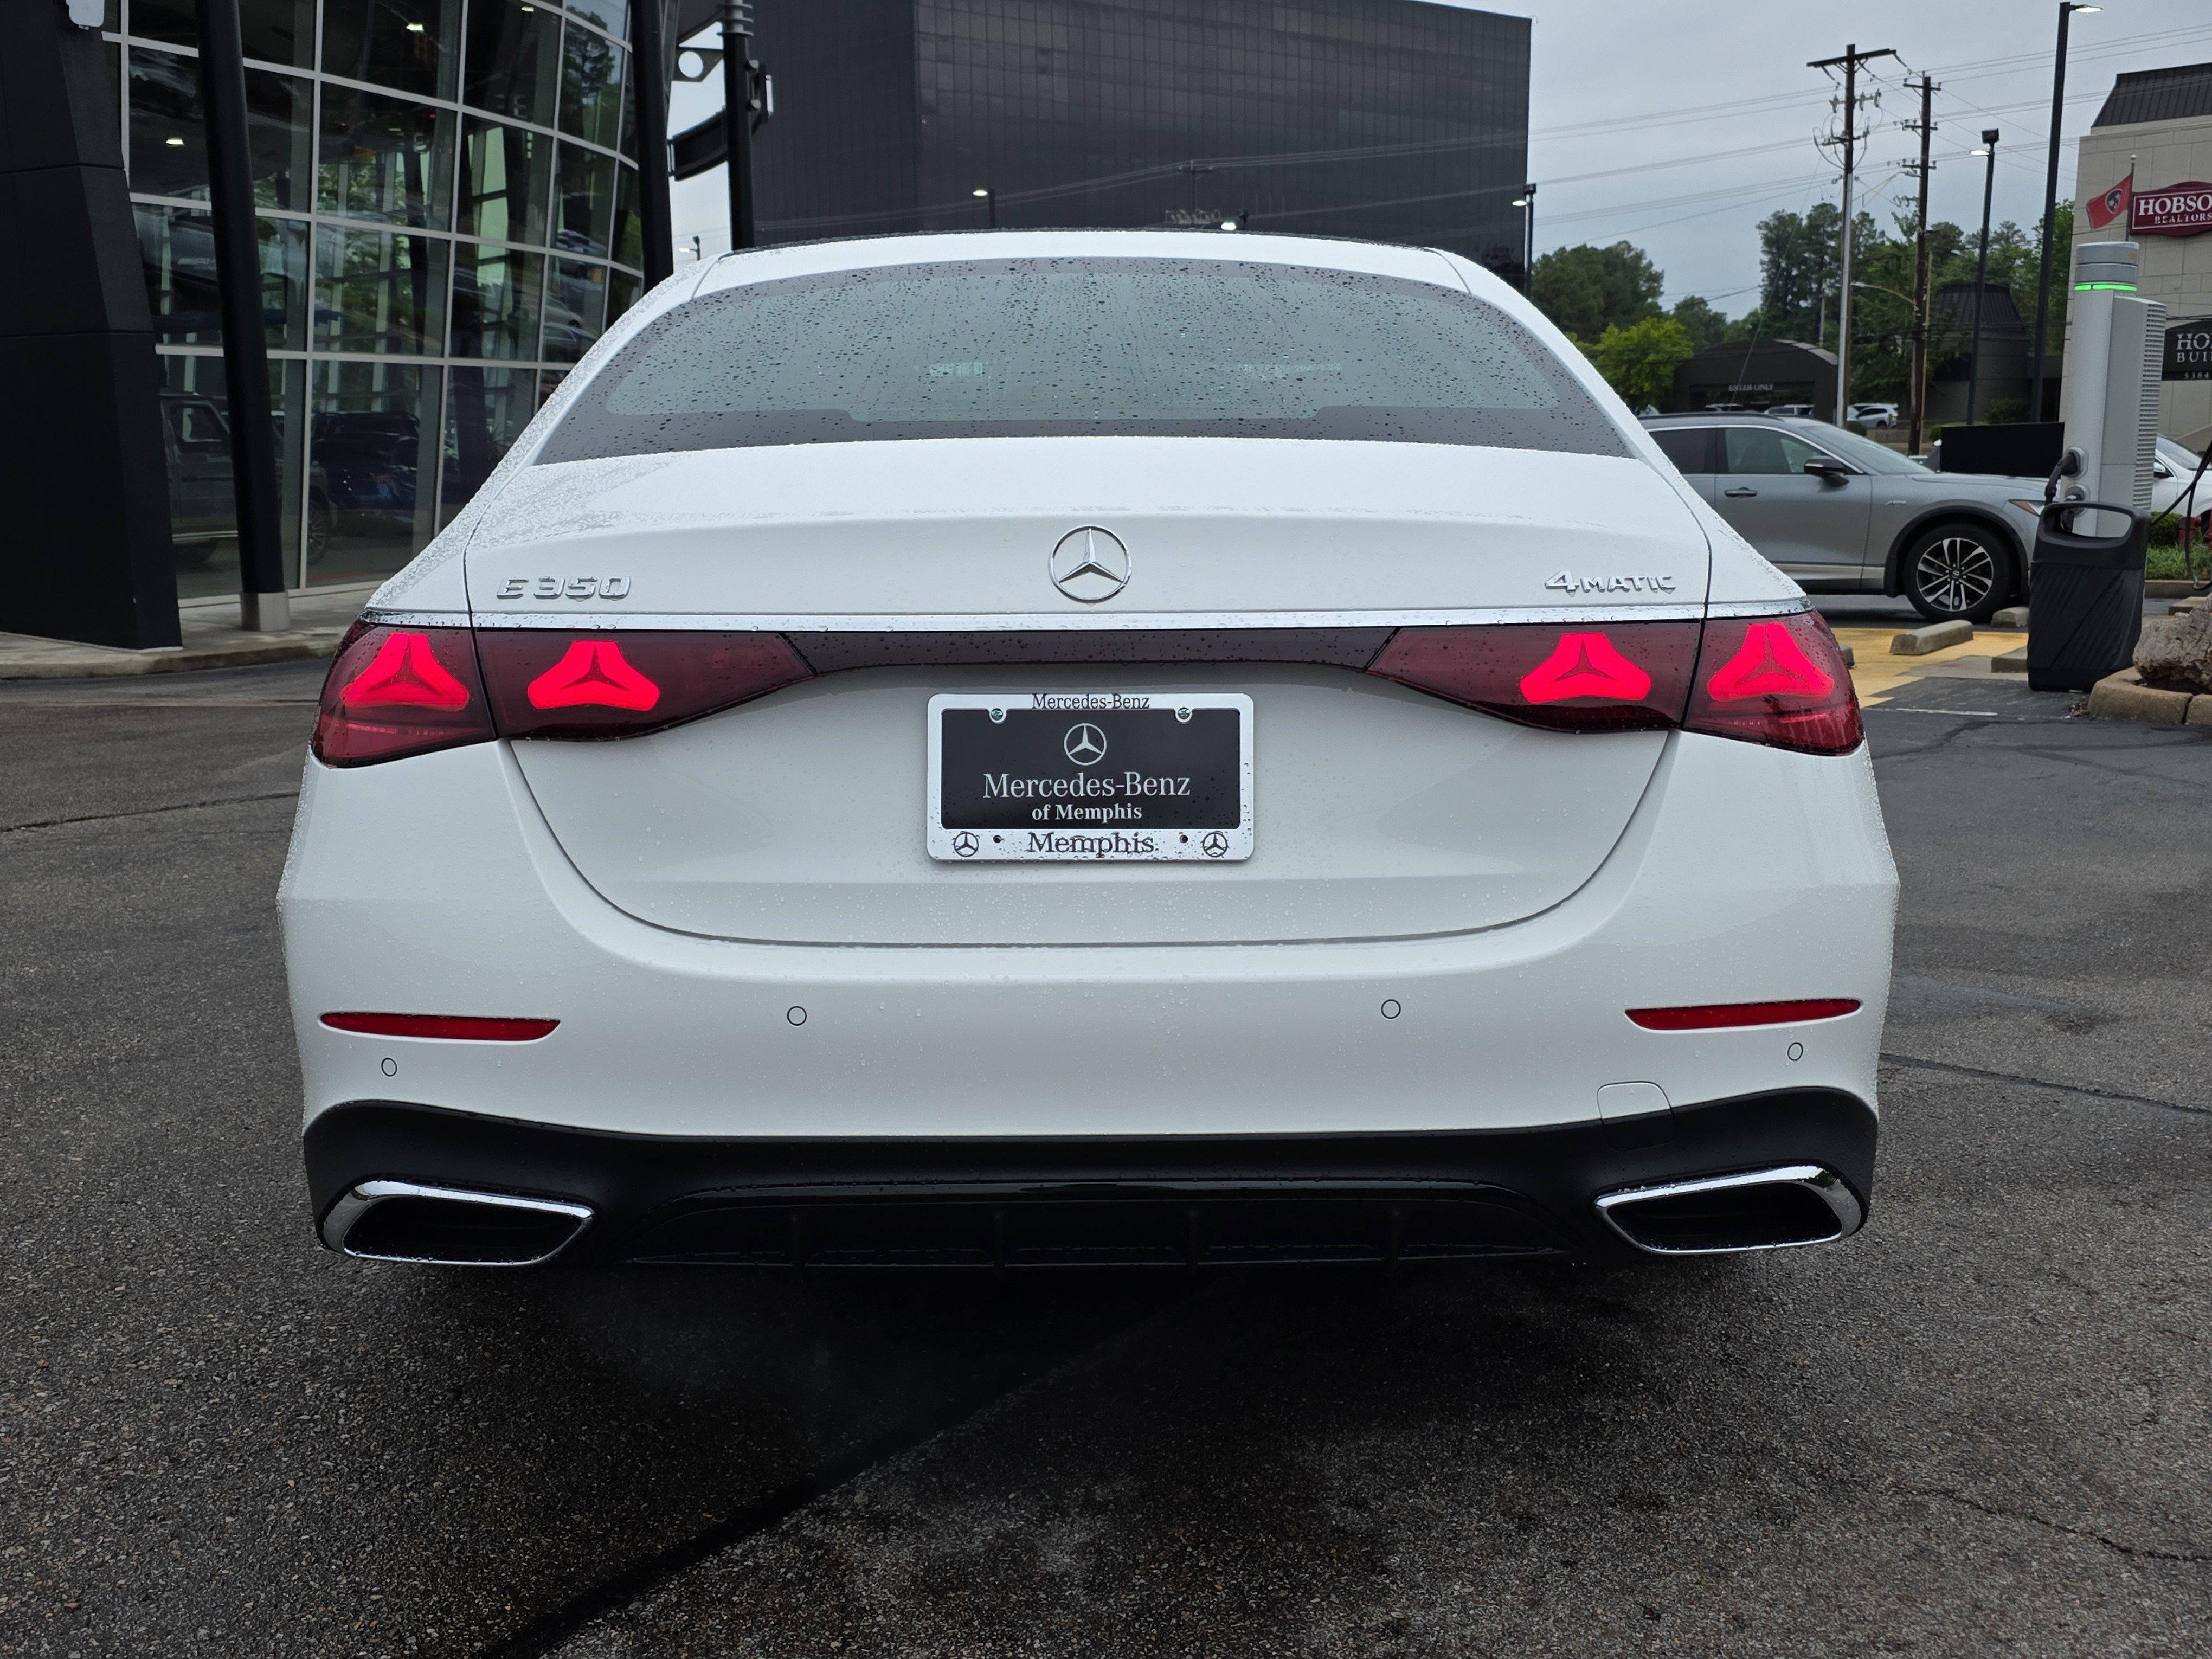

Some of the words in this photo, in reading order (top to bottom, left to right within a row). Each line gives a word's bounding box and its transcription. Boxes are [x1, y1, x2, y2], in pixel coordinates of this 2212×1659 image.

[2138, 194, 2212, 215] HOBSO
[2155, 212, 2212, 224] REALTORS
[2176, 332, 2212, 350] HO
[2176, 351, 2212, 363] BUI
[497, 576, 529, 600] E
[533, 576, 632, 600] 350
[1032, 693, 1150, 709] Mercedes-Benz
[983, 771, 1191, 799] Mercedes-Benz
[1031, 804, 1051, 821] of
[1055, 803, 1143, 824] Memphis
[1028, 831, 1155, 858] Memphis
